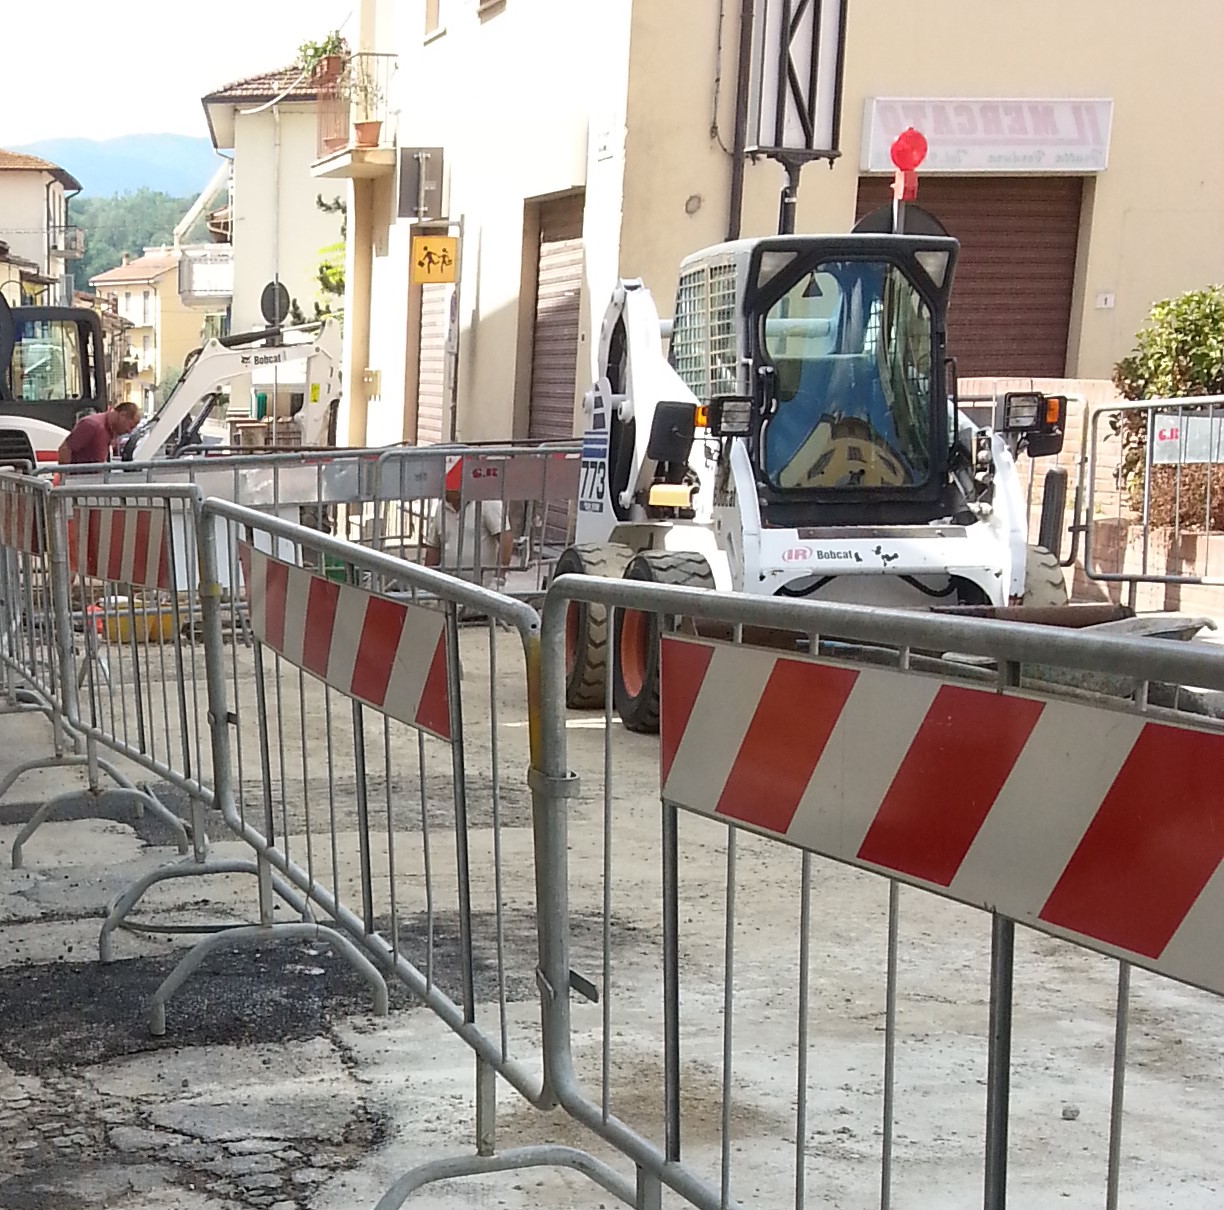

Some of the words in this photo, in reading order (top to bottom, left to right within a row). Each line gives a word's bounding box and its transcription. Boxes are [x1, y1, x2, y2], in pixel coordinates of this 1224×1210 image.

[253, 353, 282, 365] Bobcat
[579, 460, 606, 500] 773
[816, 550, 853, 560] Bobcat
